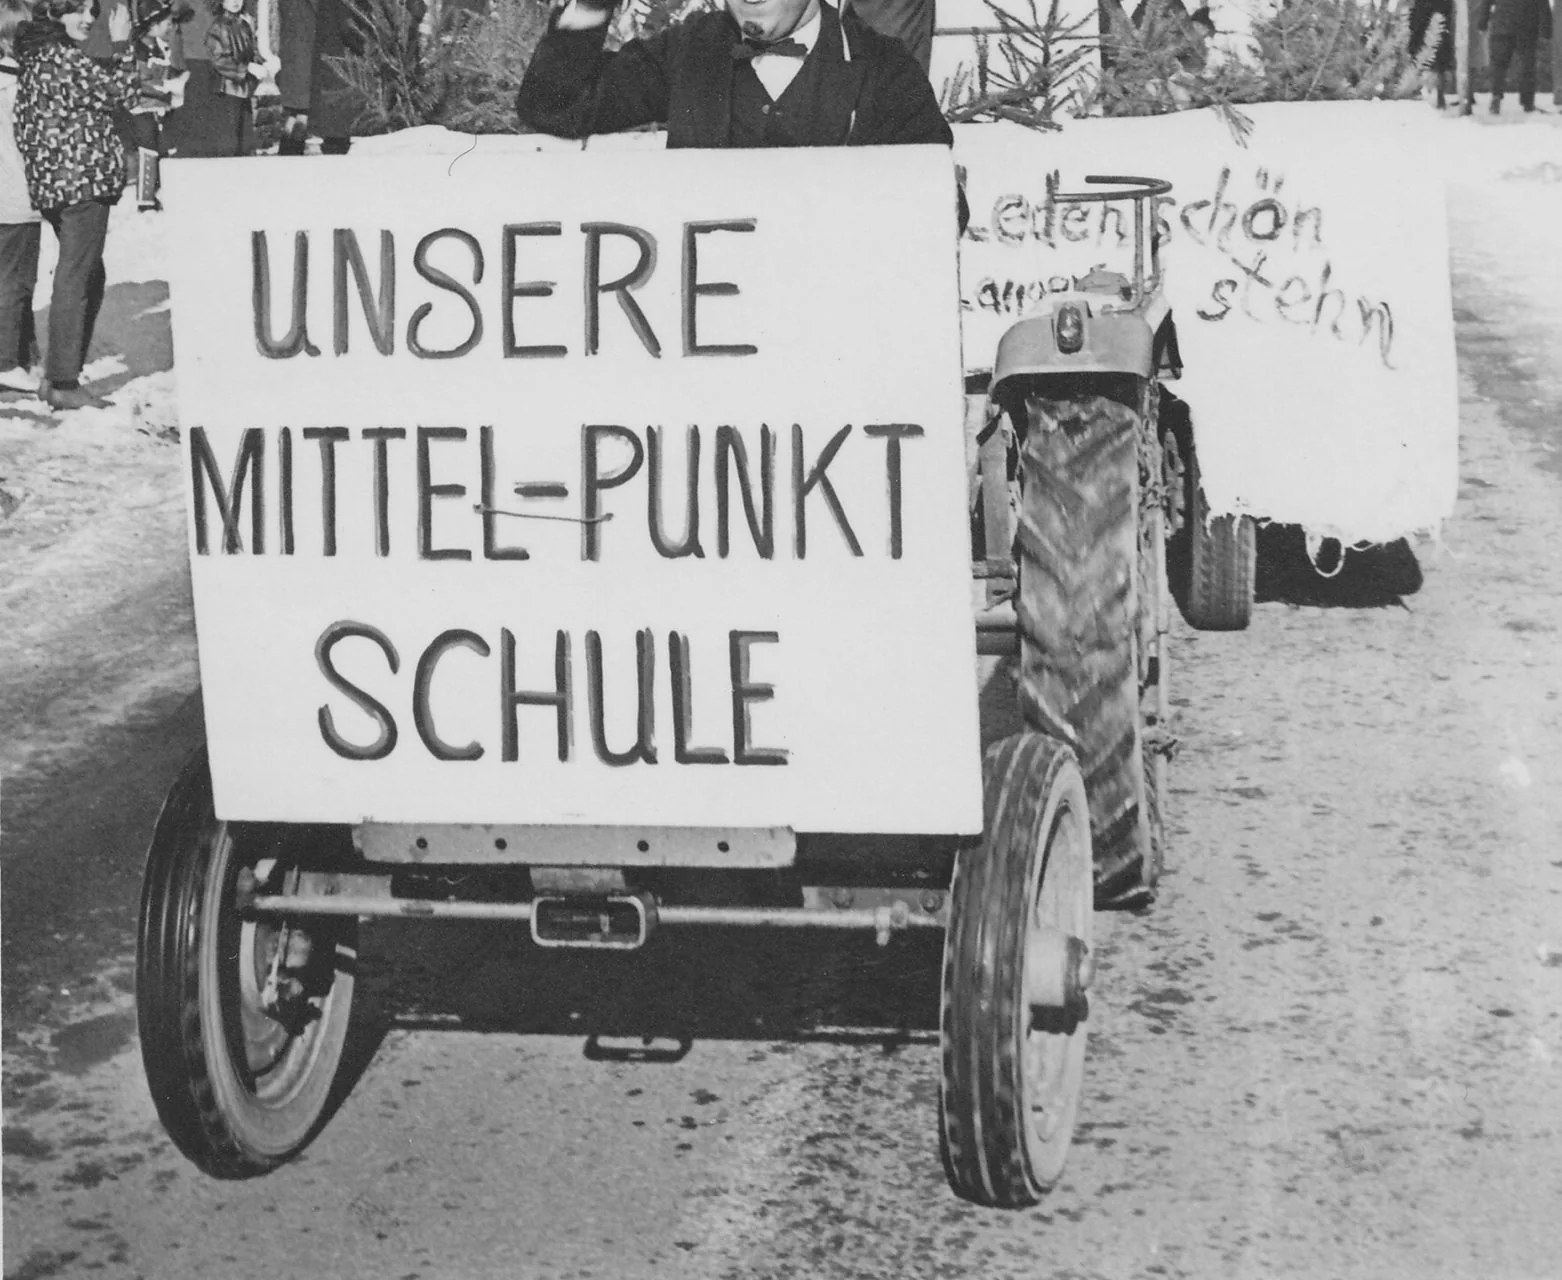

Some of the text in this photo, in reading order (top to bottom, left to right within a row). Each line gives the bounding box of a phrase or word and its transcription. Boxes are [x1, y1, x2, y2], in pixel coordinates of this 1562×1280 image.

[250, 217, 759, 361] UNSERE
[190, 422, 926, 563] MITTEL-PUNKT
[314, 618, 791, 768] SCHULE
